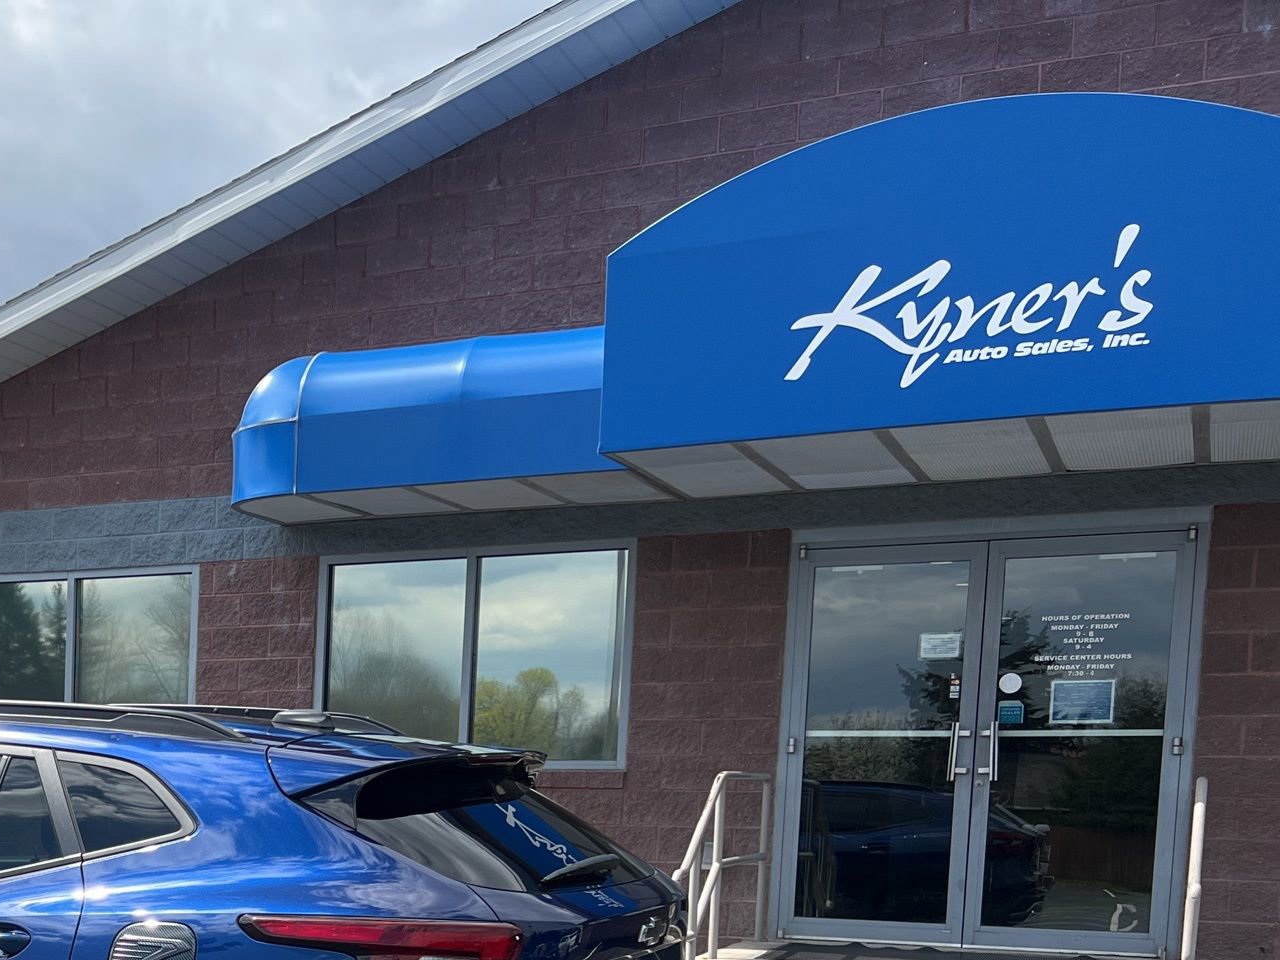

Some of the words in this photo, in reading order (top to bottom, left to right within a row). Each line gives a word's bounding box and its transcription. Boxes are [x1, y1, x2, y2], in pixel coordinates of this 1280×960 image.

[784, 224, 1154, 388] Kyner's
[943, 346, 1008, 364] Auto
[1013, 338, 1094, 357] Sales,
[1102, 332, 1150, 348] Inc.
